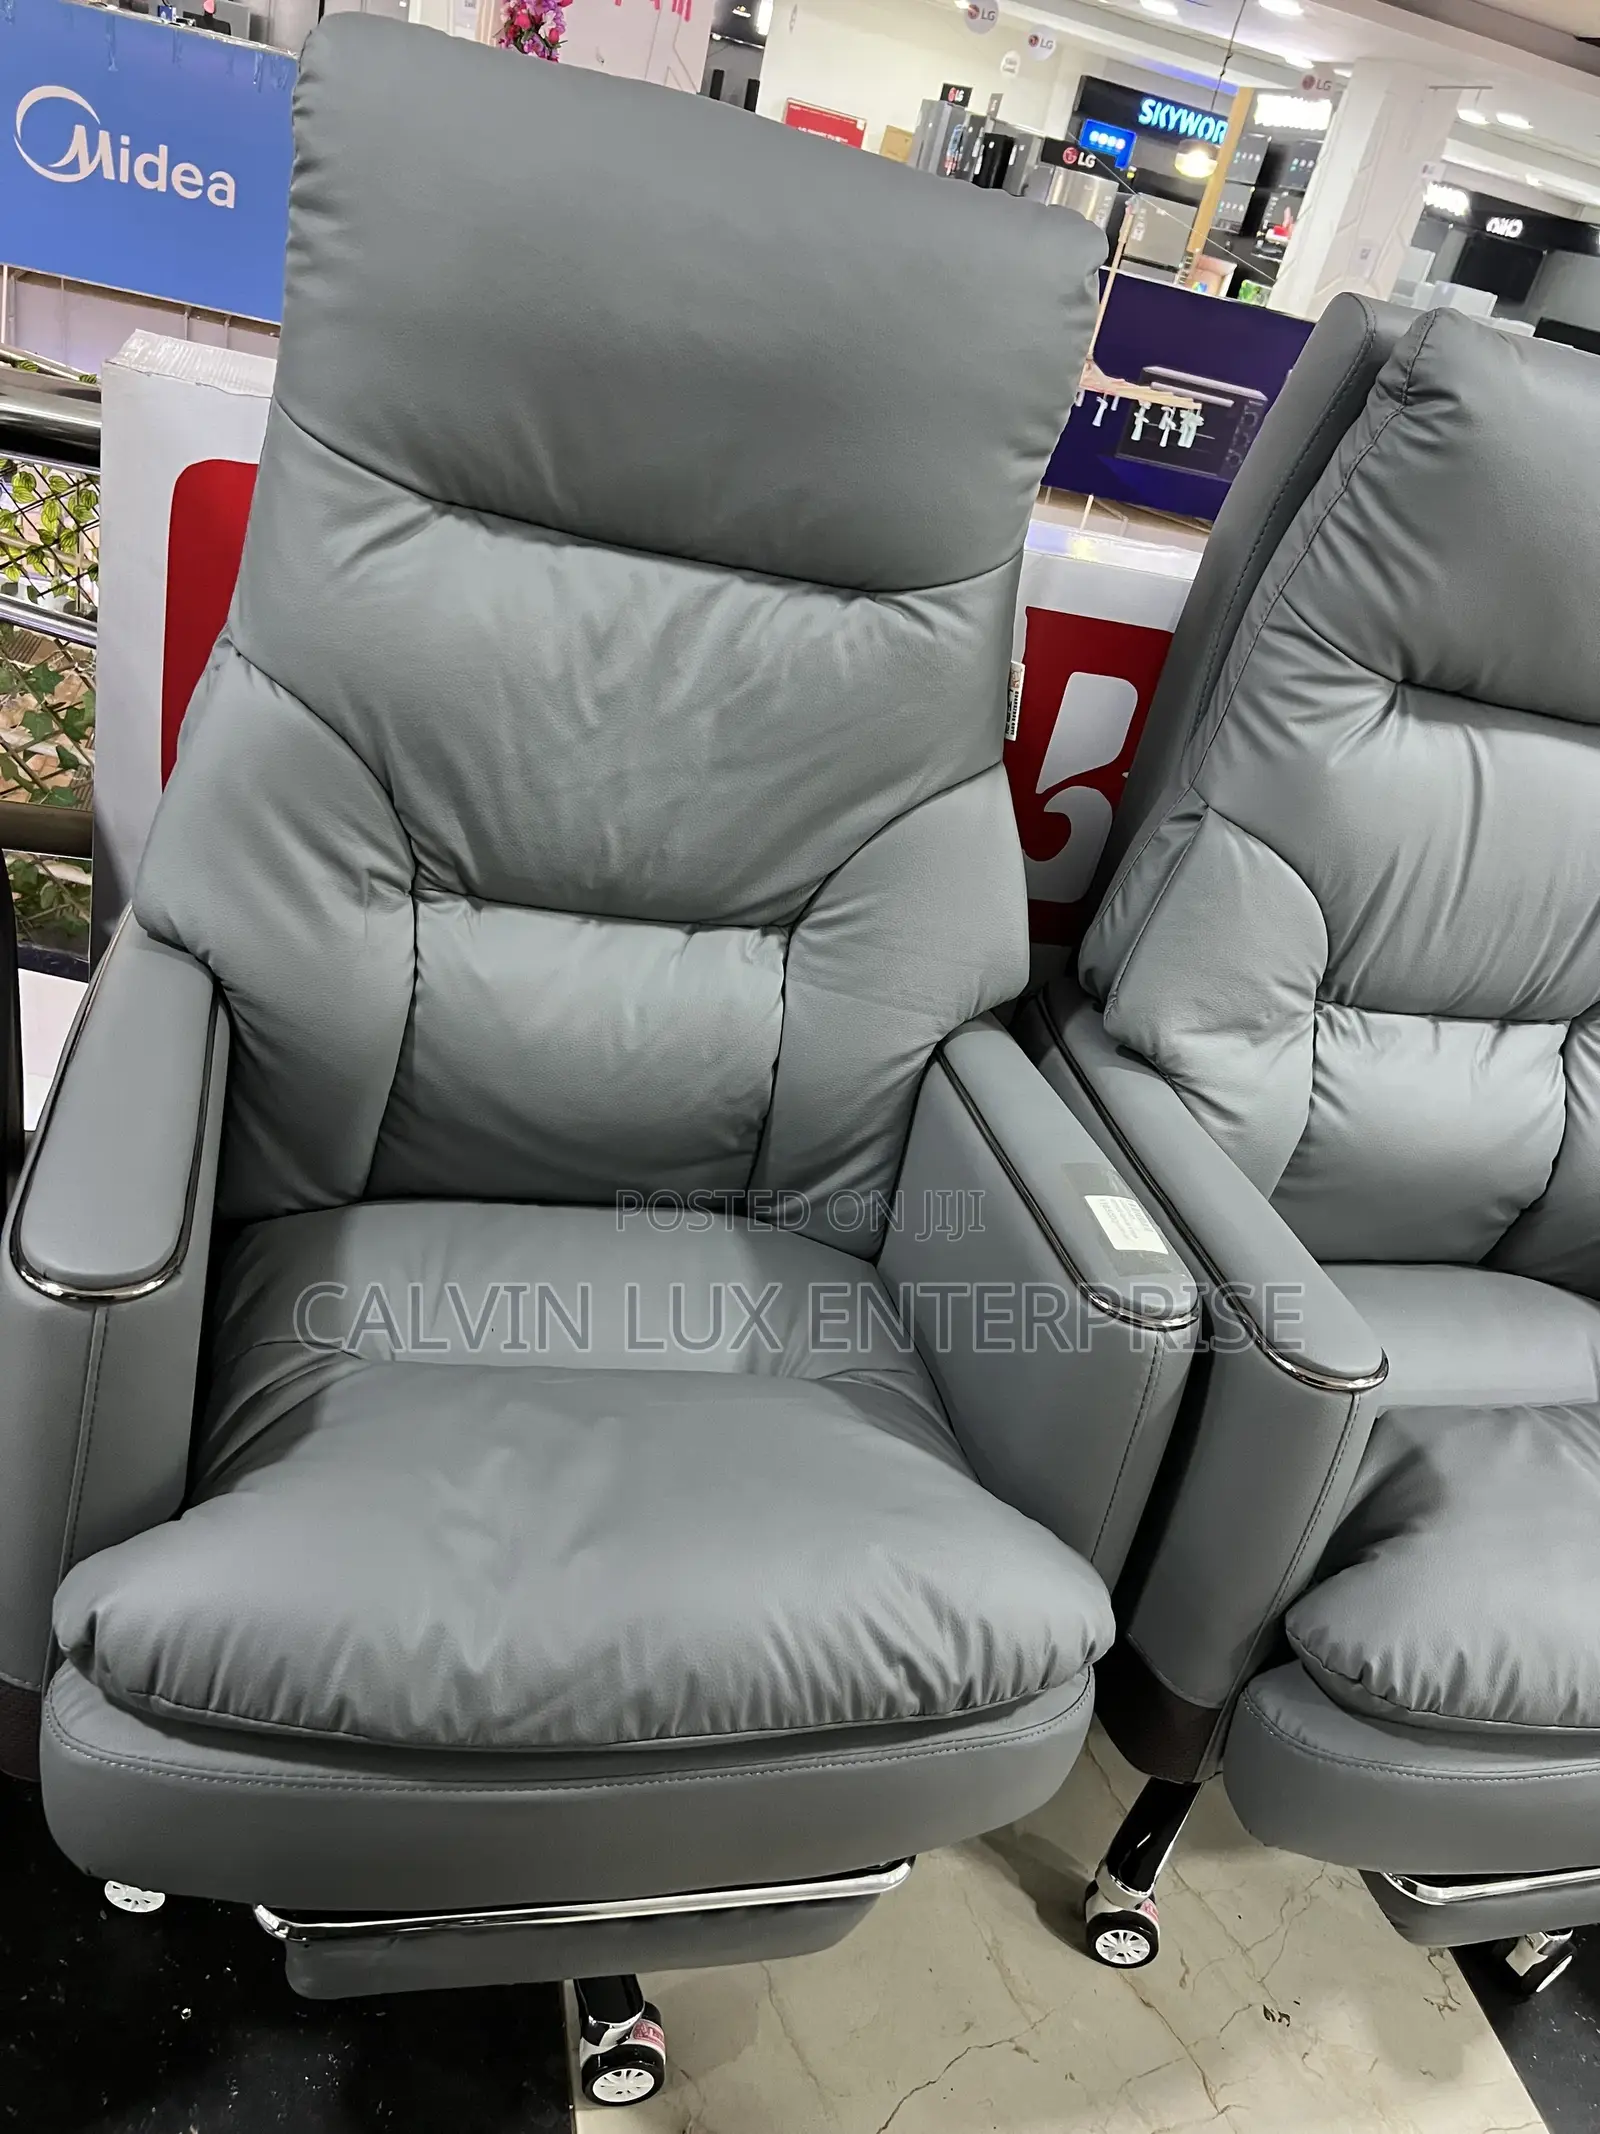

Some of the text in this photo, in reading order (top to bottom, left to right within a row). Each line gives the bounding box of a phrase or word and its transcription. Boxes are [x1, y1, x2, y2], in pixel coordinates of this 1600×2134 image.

[981, 9, 996, 21] LG
[1040, 39, 1053, 50] LG
[1316, 79, 1333, 91] LG
[13, 124, 236, 208] Midea
[1077, 151, 1097, 169] LG
